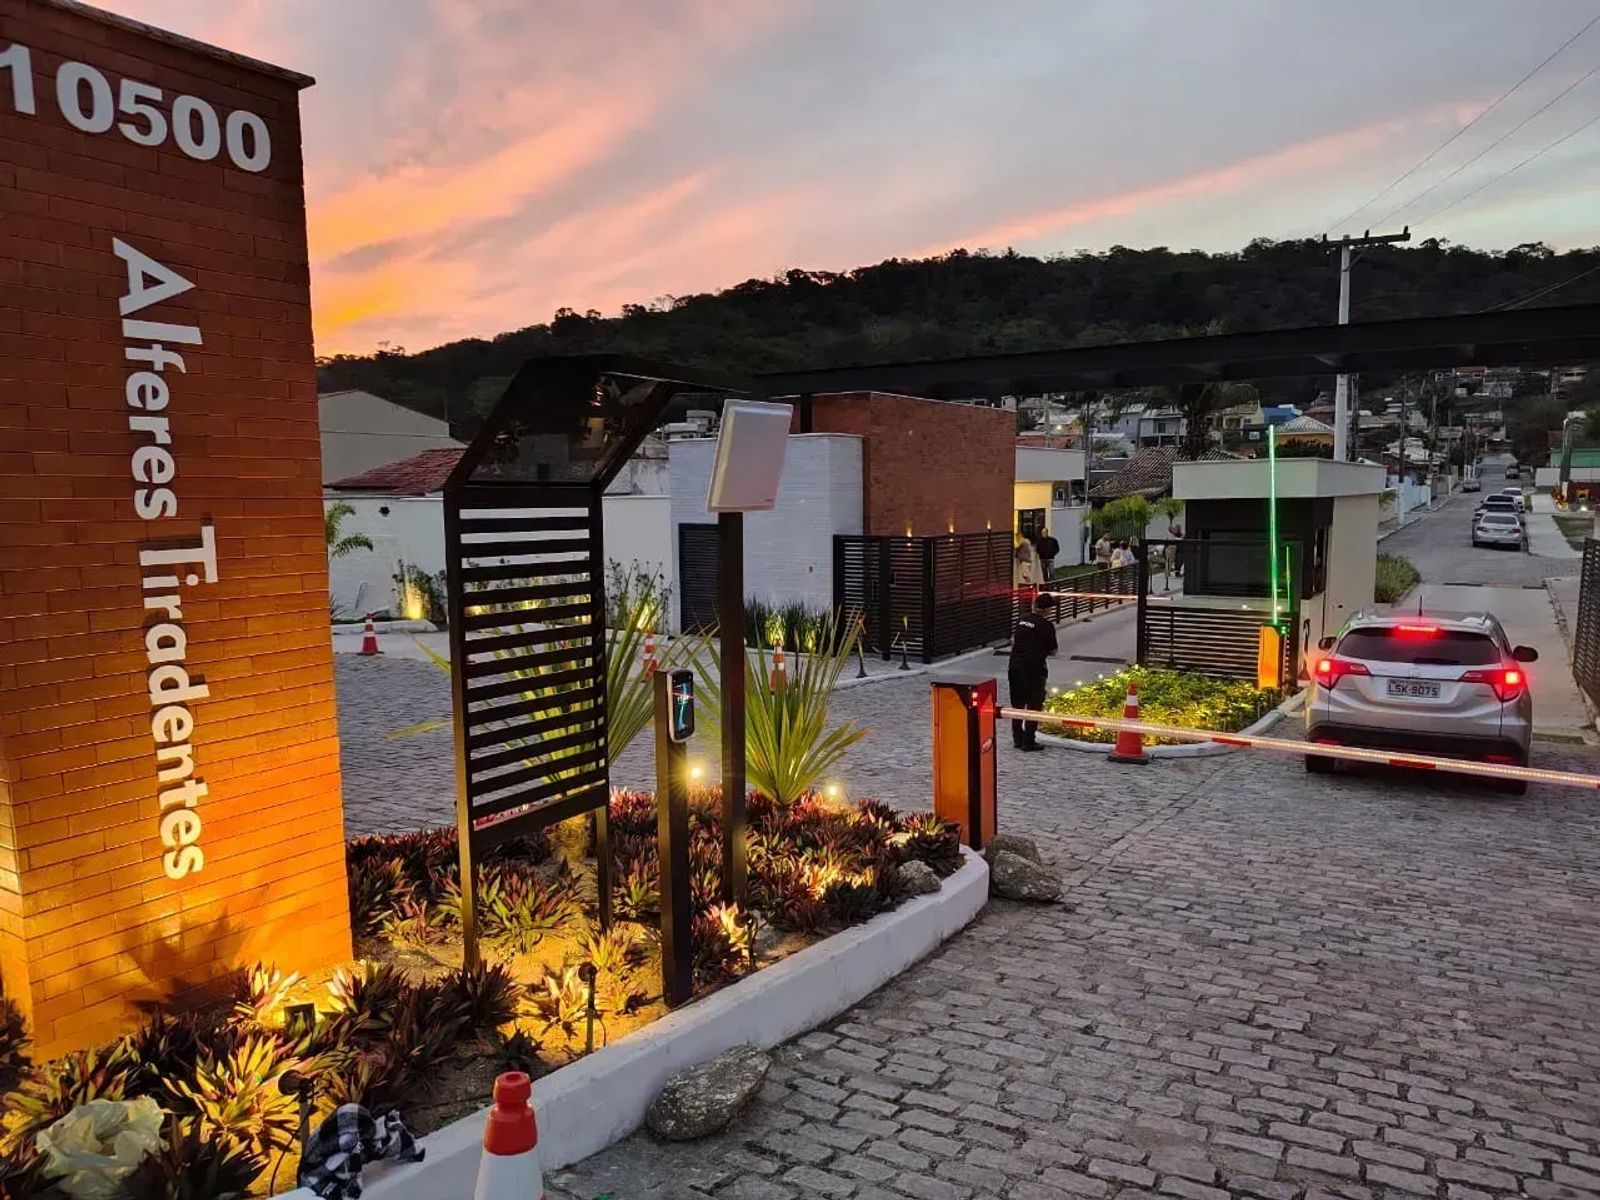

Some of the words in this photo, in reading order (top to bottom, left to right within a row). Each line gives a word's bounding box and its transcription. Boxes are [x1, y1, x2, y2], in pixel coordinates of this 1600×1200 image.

[0, 43, 272, 173] 10500
[112, 236, 203, 520] Alferes
[139, 525, 218, 880] Tiradentes
